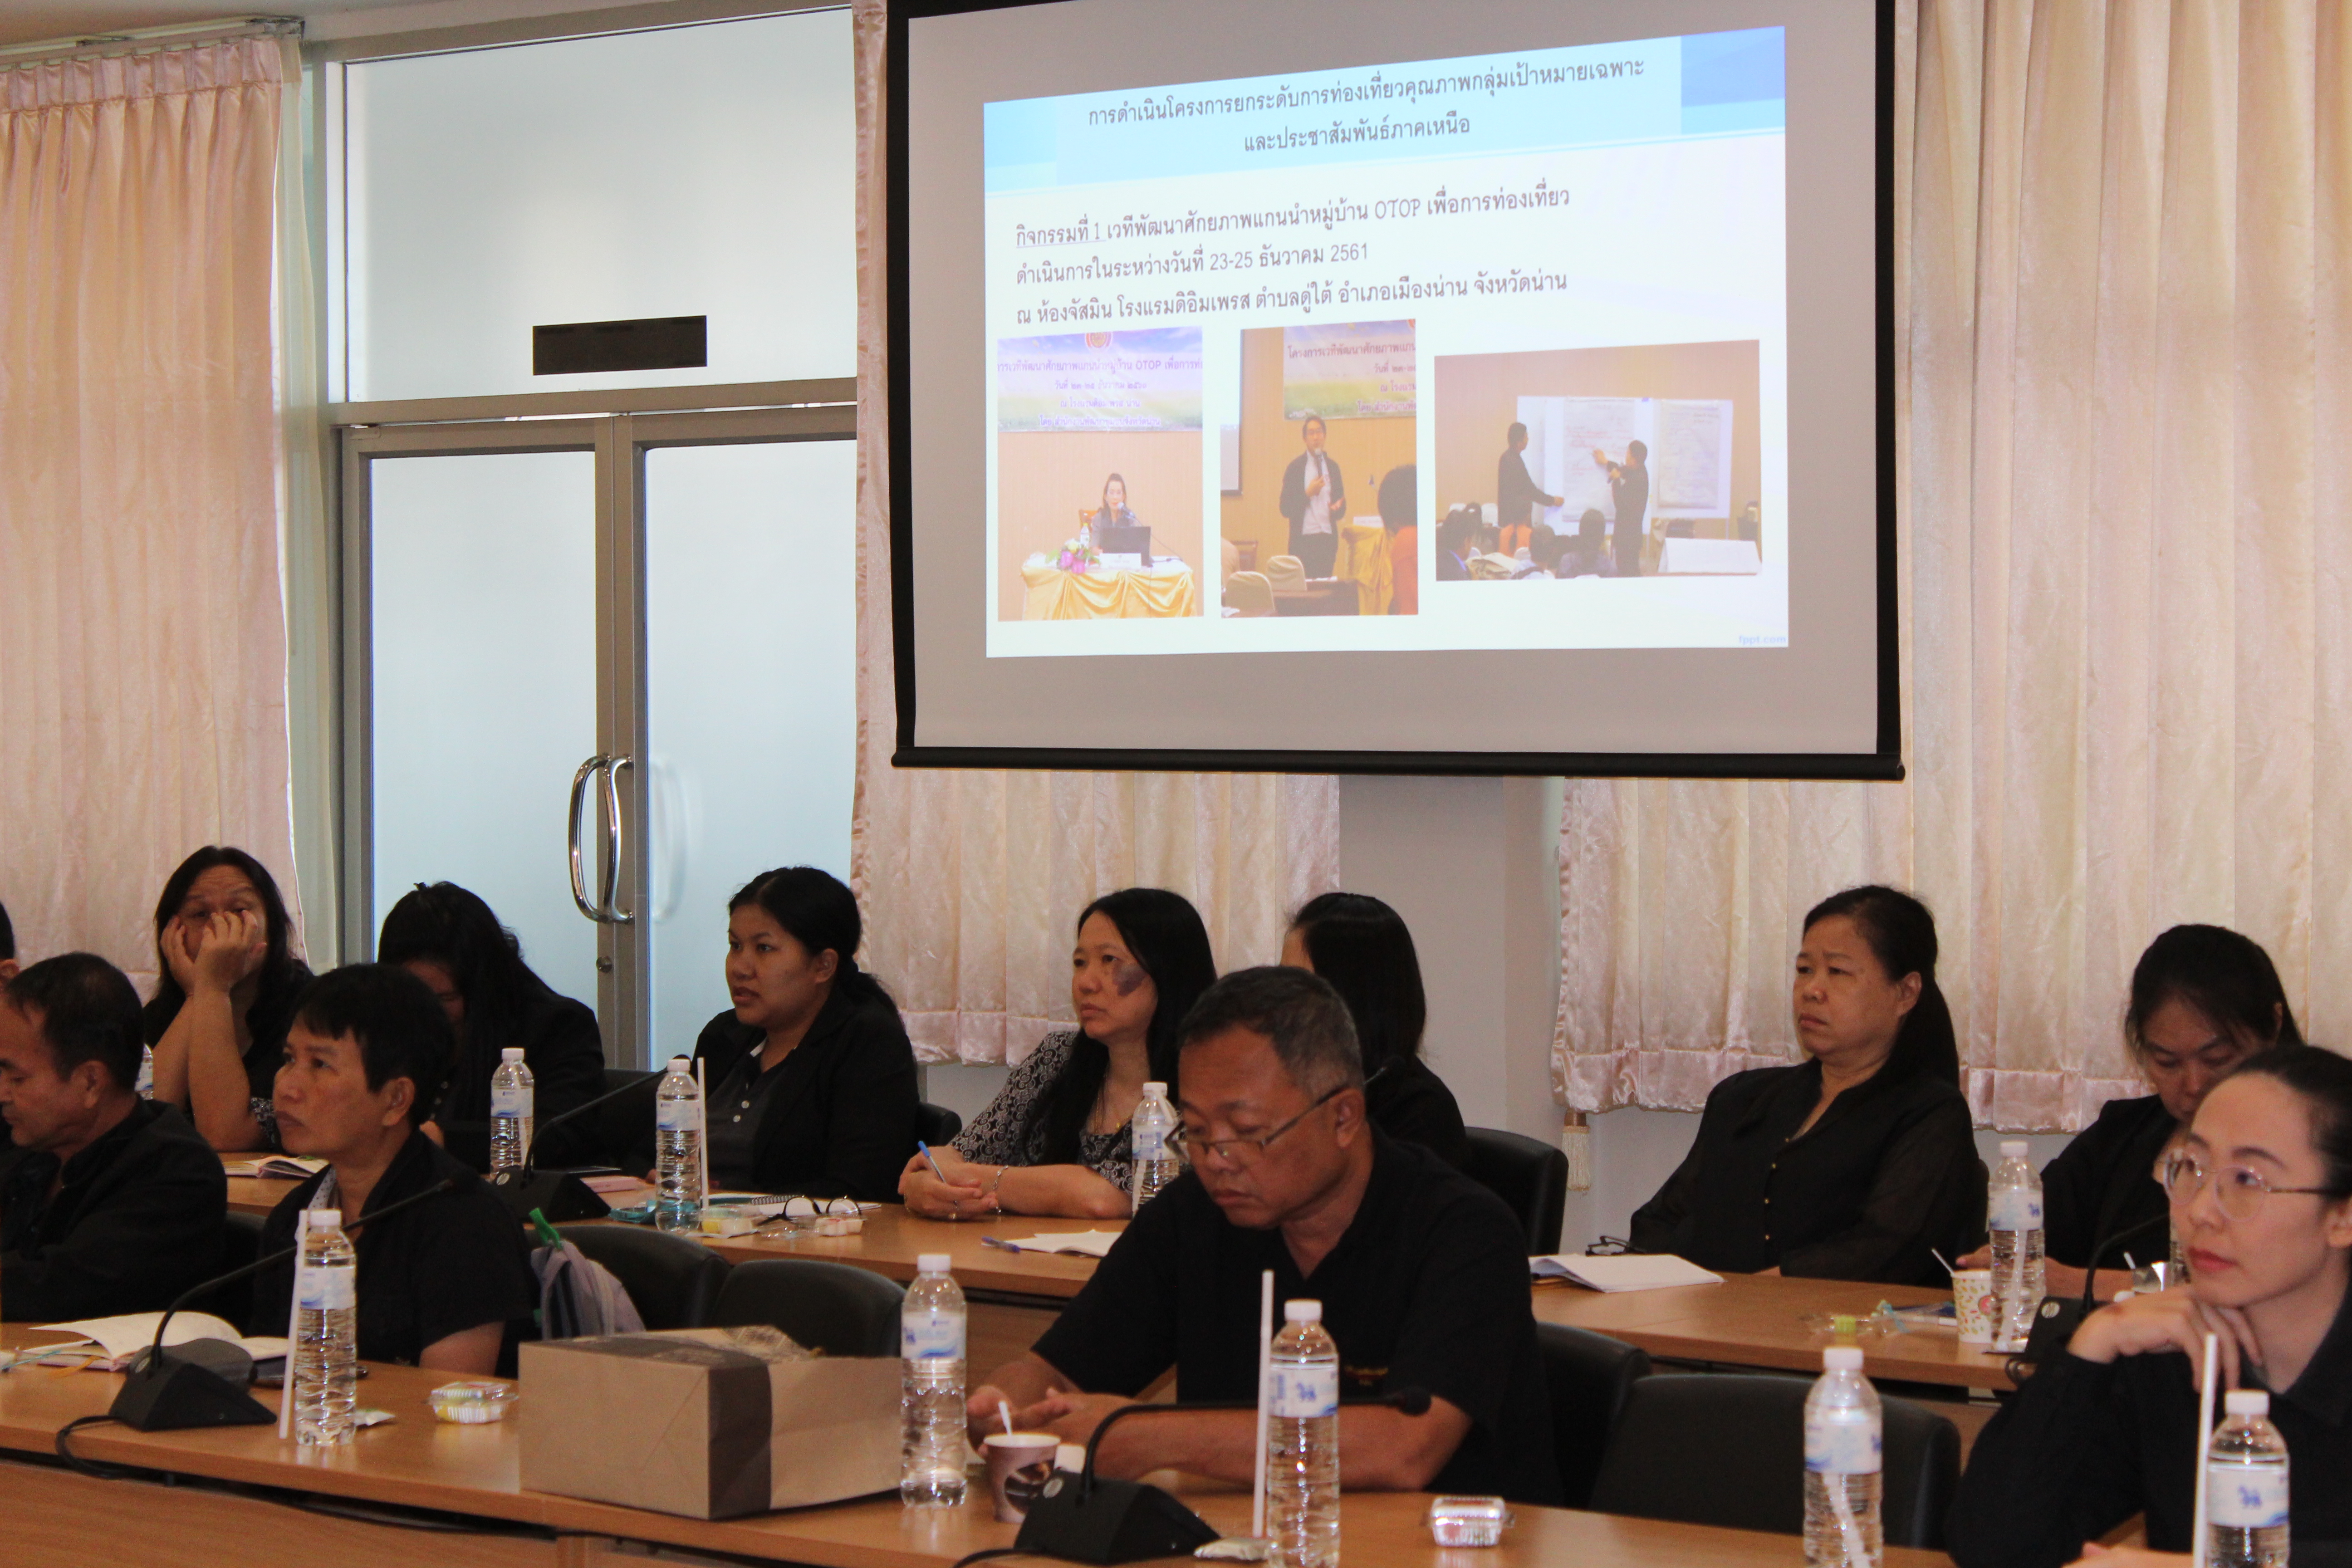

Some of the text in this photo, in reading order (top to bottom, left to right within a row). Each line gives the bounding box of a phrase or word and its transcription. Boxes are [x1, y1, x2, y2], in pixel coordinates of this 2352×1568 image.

[1088, 62, 1645, 126] การดำเนินโครงการยกระดับการท่องเที่ยวคุณภาพกลุ่มเป้าหมายเฉพาะ
[1244, 110, 1470, 152] และประชาสัมพันธ์ภาคเหนือ
[1016, 177, 1570, 245] กิจกรรมที่ 1 เวทีพัฒนาศักยภาพแกนนำหมู่บ้าน OTOP เพื่อการท่องเที่ยว
[1016, 242, 1367, 285] ดำเนินการในระหว่างวันที่ 23-25 ธันวาคม 2561
[1017, 268, 1568, 325] ณ ห้องจัสมิน โรงแรมดิอิมเพรส ตำบลดู่ใต้ อำเภอเมืองน่าน จังหวัดน่าน
